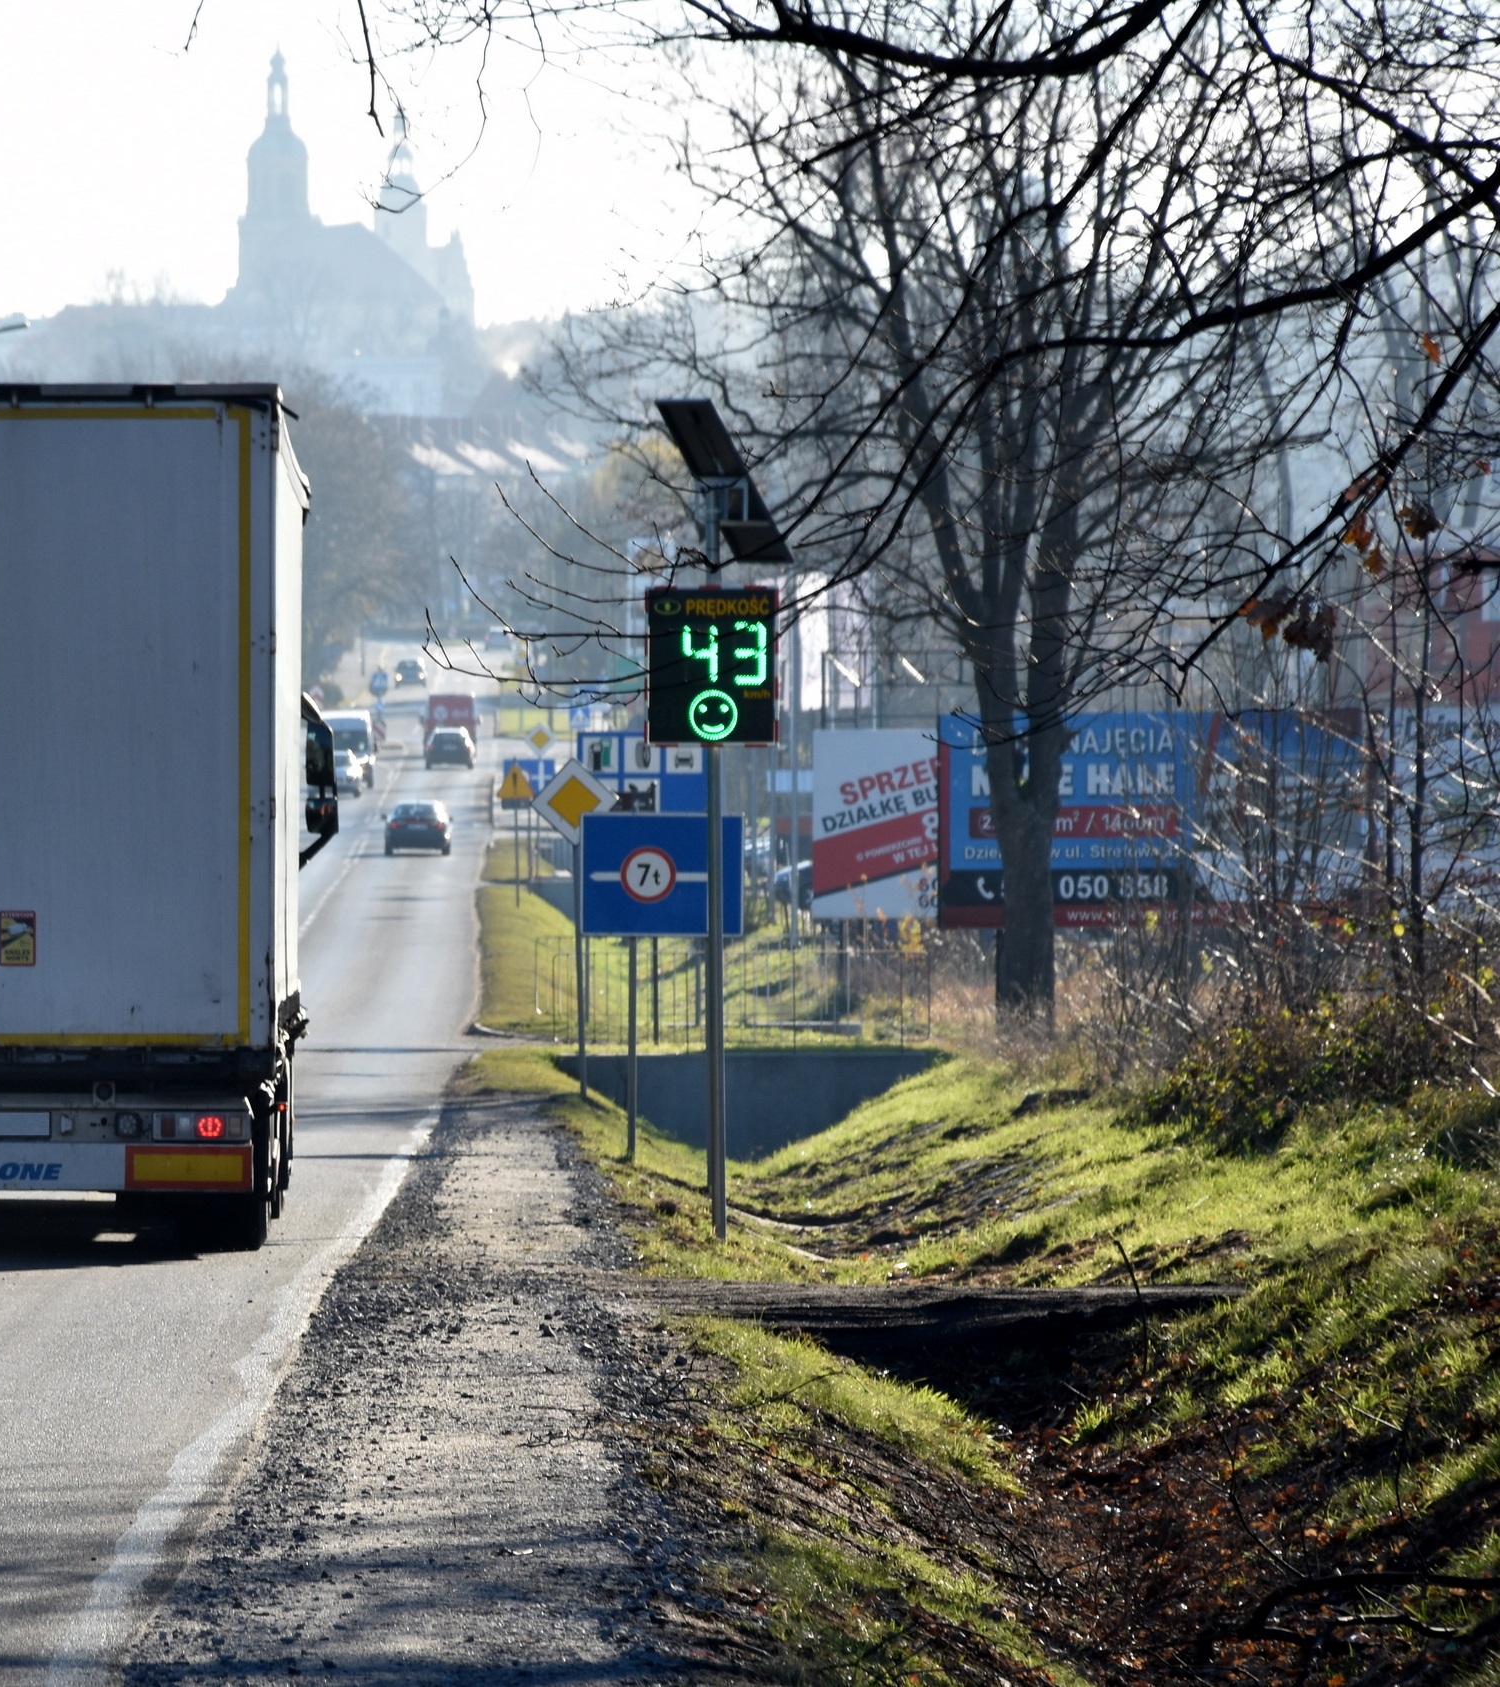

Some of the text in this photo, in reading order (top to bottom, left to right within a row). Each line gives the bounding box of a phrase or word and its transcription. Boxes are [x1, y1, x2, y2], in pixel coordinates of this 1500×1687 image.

[685, 595, 770, 619] PRĘDKOŚĆ
[682, 620, 767, 686] 43
[743, 689, 771, 699] km/h
[1087, 761, 1176, 797] HALE
[822, 794, 909, 833] DZIAŁKĘ
[893, 852, 906, 864] W
[909, 844, 930, 860] TEJ
[1059, 875, 1109, 899] 050
